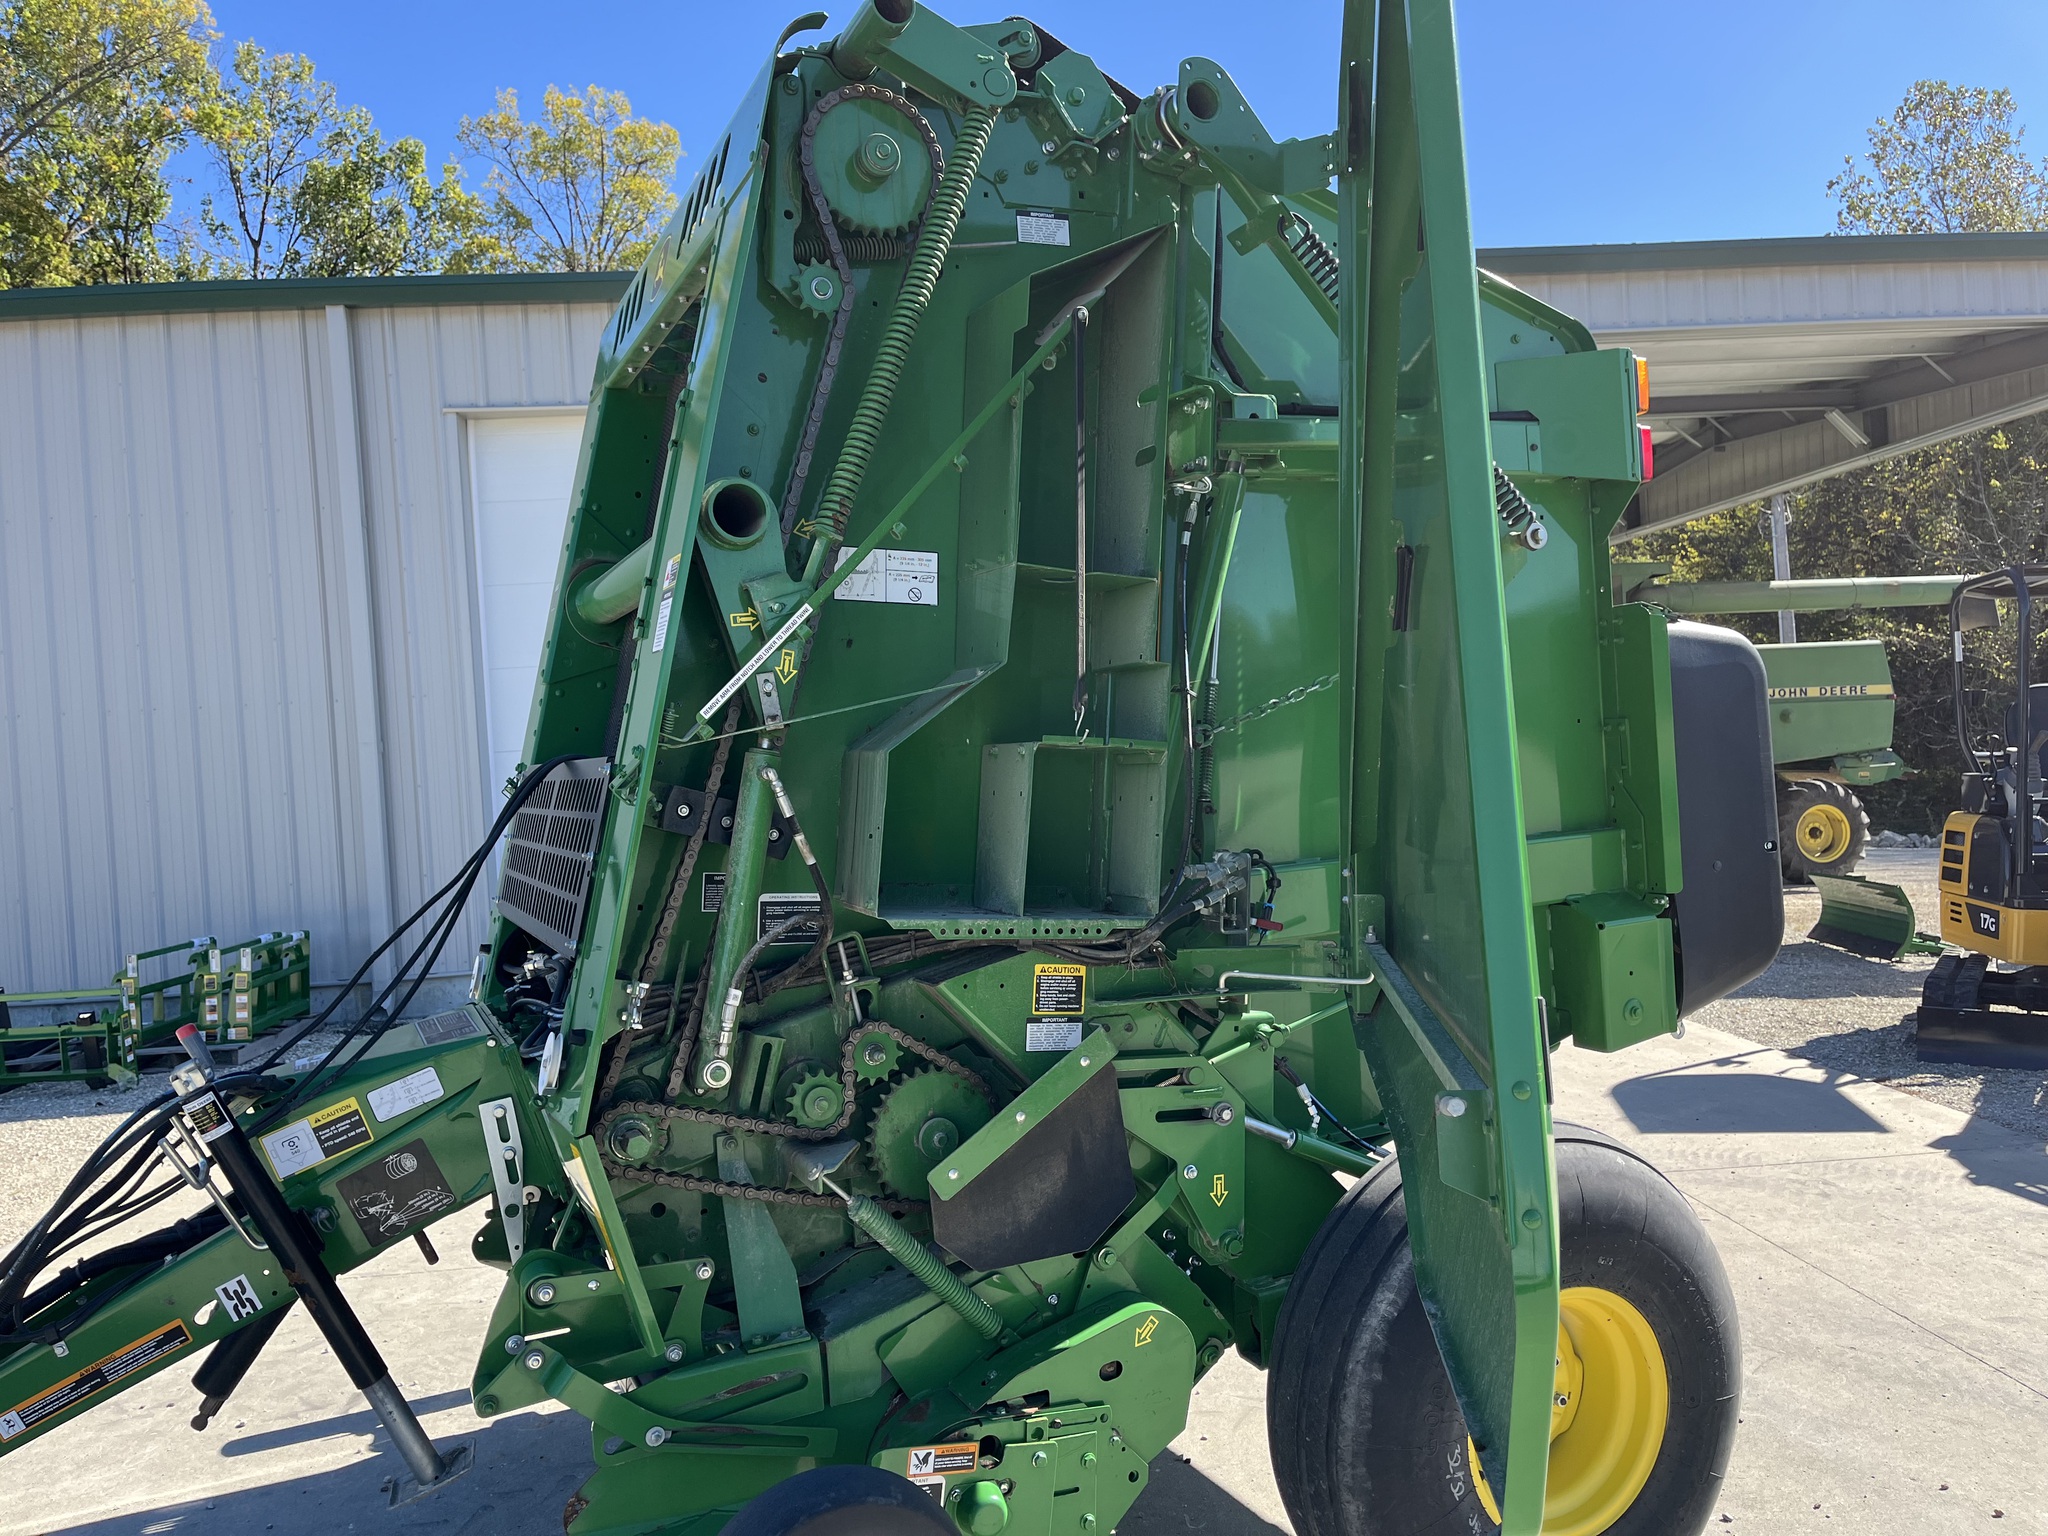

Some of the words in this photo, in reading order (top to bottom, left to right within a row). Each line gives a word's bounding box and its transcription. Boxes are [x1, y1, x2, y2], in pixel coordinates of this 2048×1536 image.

[702, 697, 721, 716] REMOVE
[719, 688, 731, 699] ARM
[728, 676, 742, 690] FROM
[740, 663, 755, 678] NOTCH
[755, 654, 764, 665] AND
[762, 640, 778, 655] LOWER
[781, 619, 798, 636] THREAD
[796, 606, 810, 620] TWINE
[1769, 687, 1808, 698] JOHN
[1819, 685, 1868, 696] DEERE
[1979, 912, 1996, 932] 17G
[1046, 966, 1081, 974] CAUTION
[321, 1103, 352, 1120] CAUTION
[84, 1353, 117, 1373] WARNING
